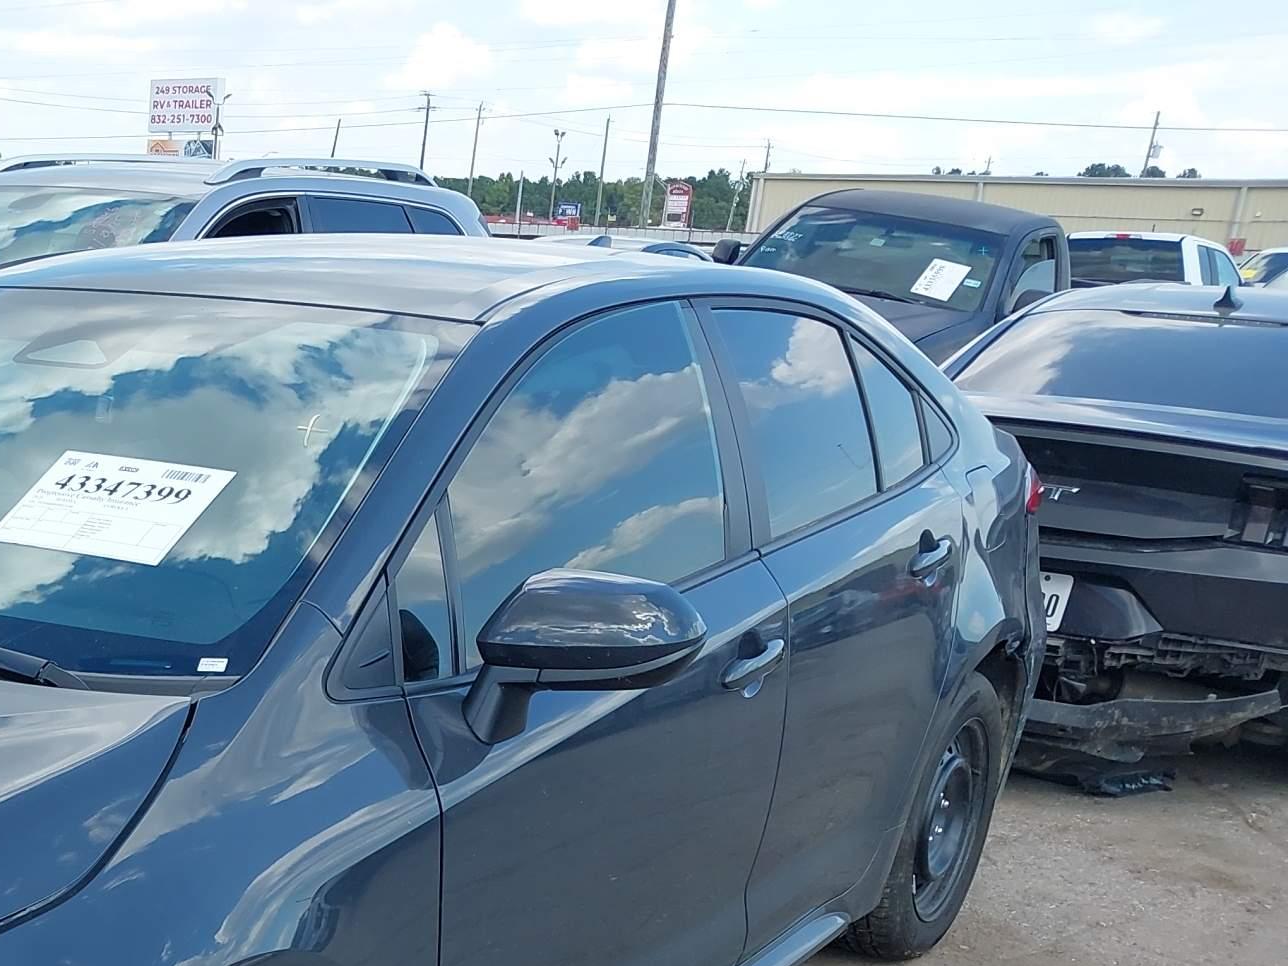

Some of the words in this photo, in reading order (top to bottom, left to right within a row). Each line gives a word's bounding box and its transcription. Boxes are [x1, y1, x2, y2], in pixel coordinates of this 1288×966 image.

[172, 85, 211, 94] STORAGE
[152, 100, 166, 110] RV
[172, 100, 212, 109] TRAILER
[151, 114, 213, 124] 832-251-7300
[54, 473, 192, 505] 43347399
